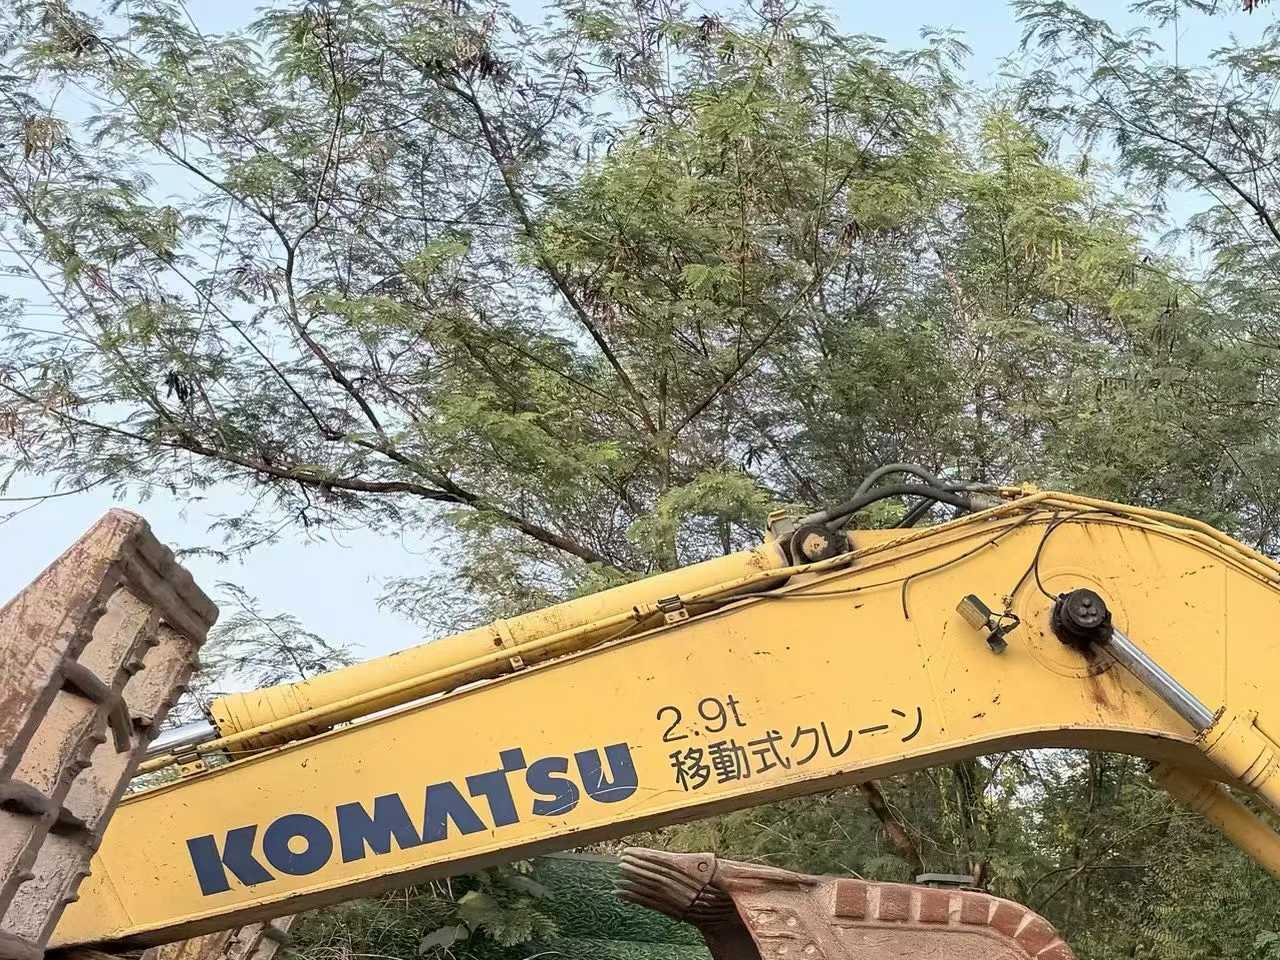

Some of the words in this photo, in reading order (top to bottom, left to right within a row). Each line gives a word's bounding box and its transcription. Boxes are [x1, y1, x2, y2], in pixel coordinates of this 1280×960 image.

[656, 694, 746, 743] 2.9t
[669, 705, 926, 793] 移動式クレーン
[187, 744, 639, 897] KOMATSU
